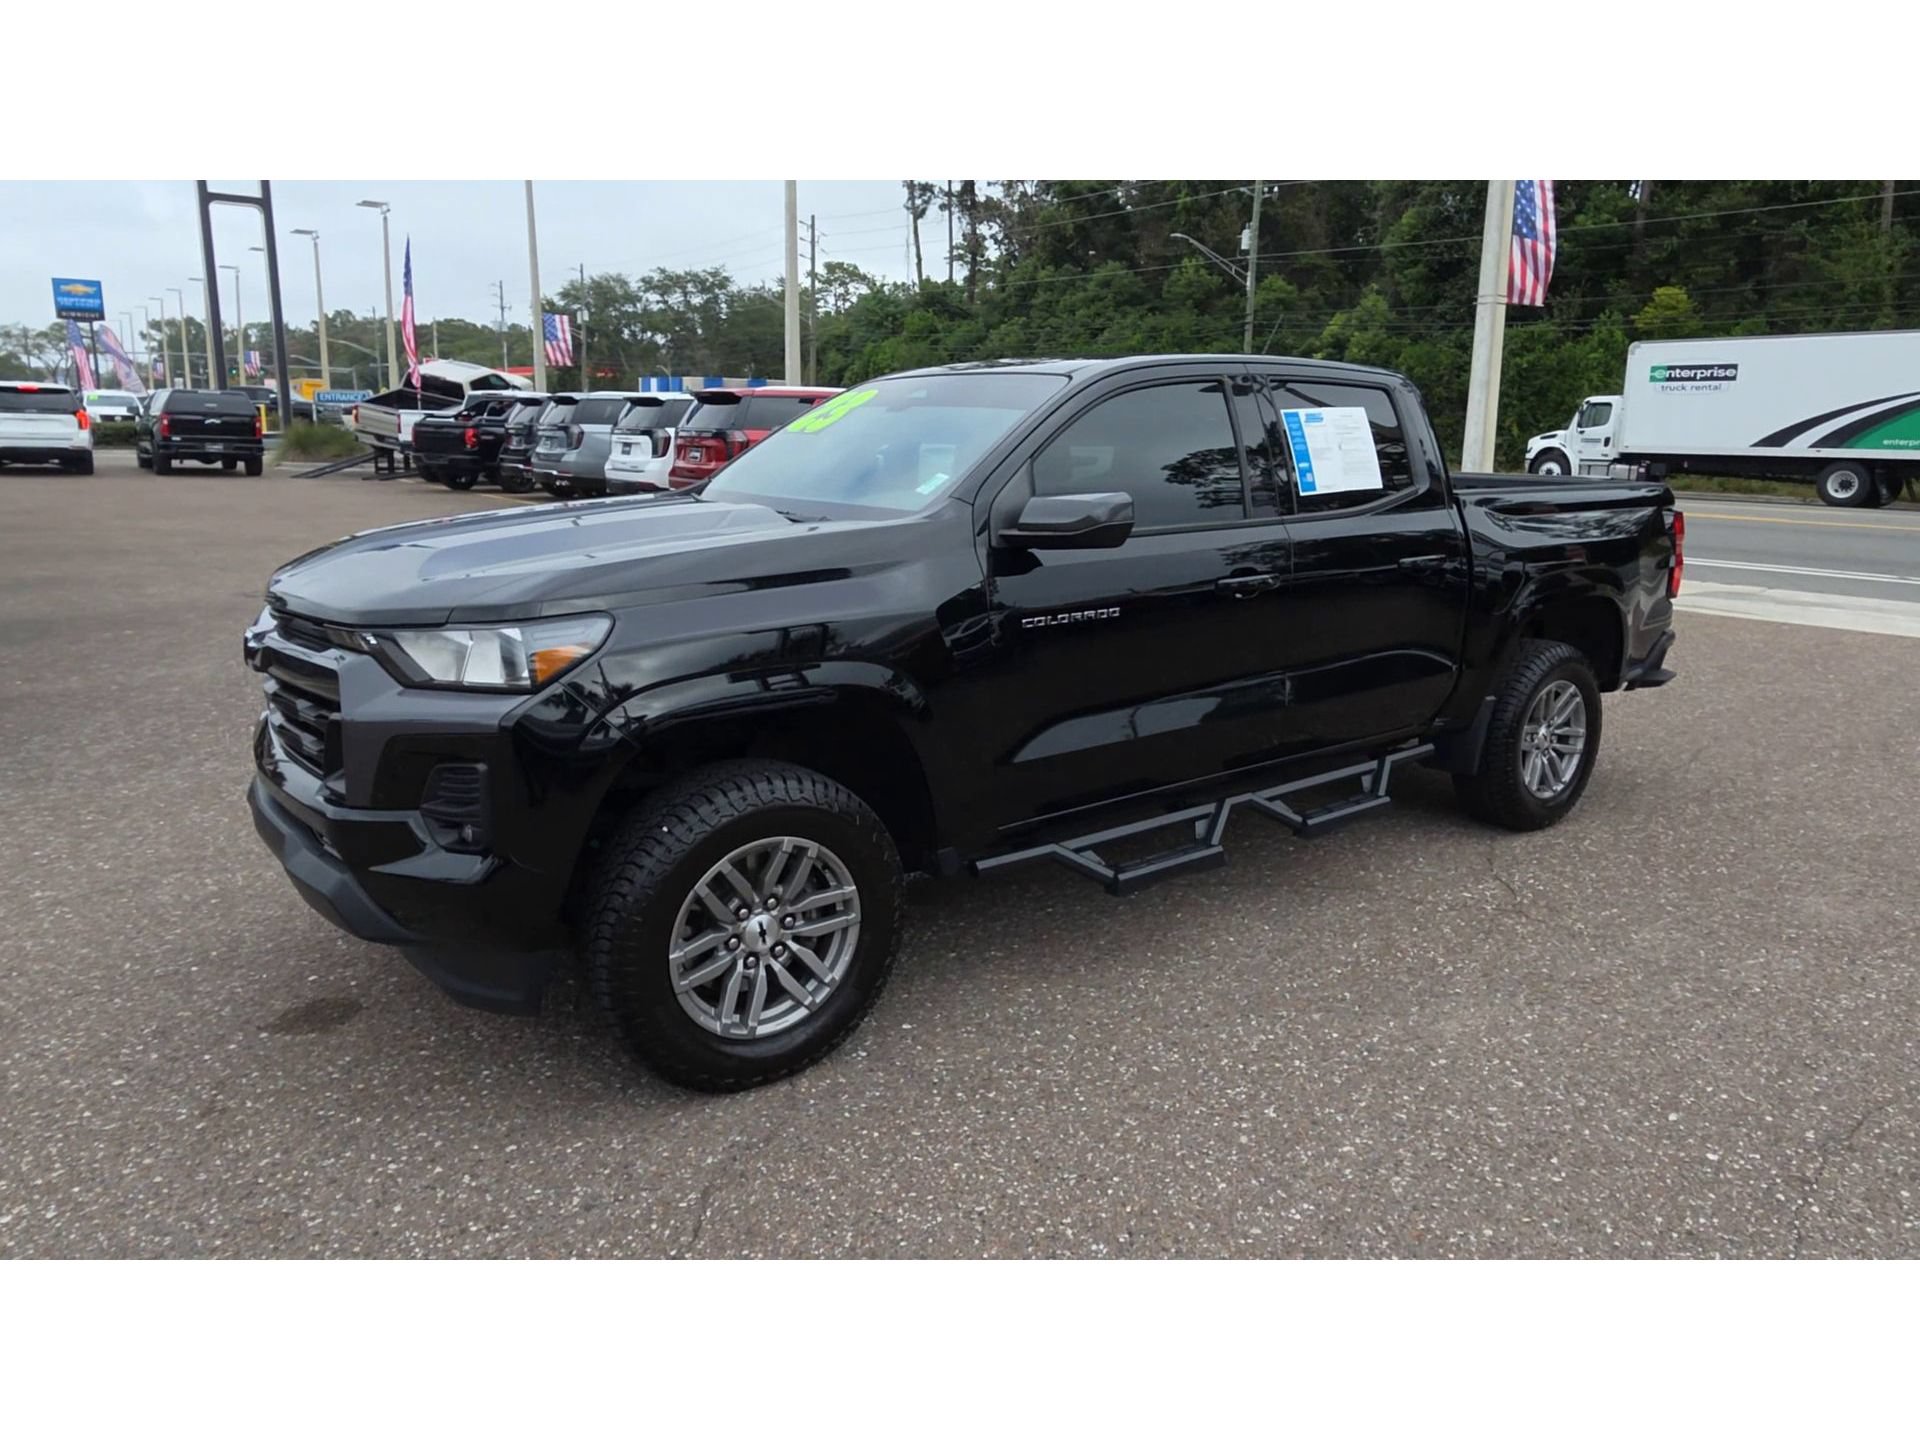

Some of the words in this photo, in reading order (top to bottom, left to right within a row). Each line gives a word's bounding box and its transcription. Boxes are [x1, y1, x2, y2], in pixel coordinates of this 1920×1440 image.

[1654, 366, 1737, 380] enterprise
[1660, 383, 1687, 392] truck
[1690, 383, 1722, 391] rental
[1022, 607, 1120, 628] COLORADO
